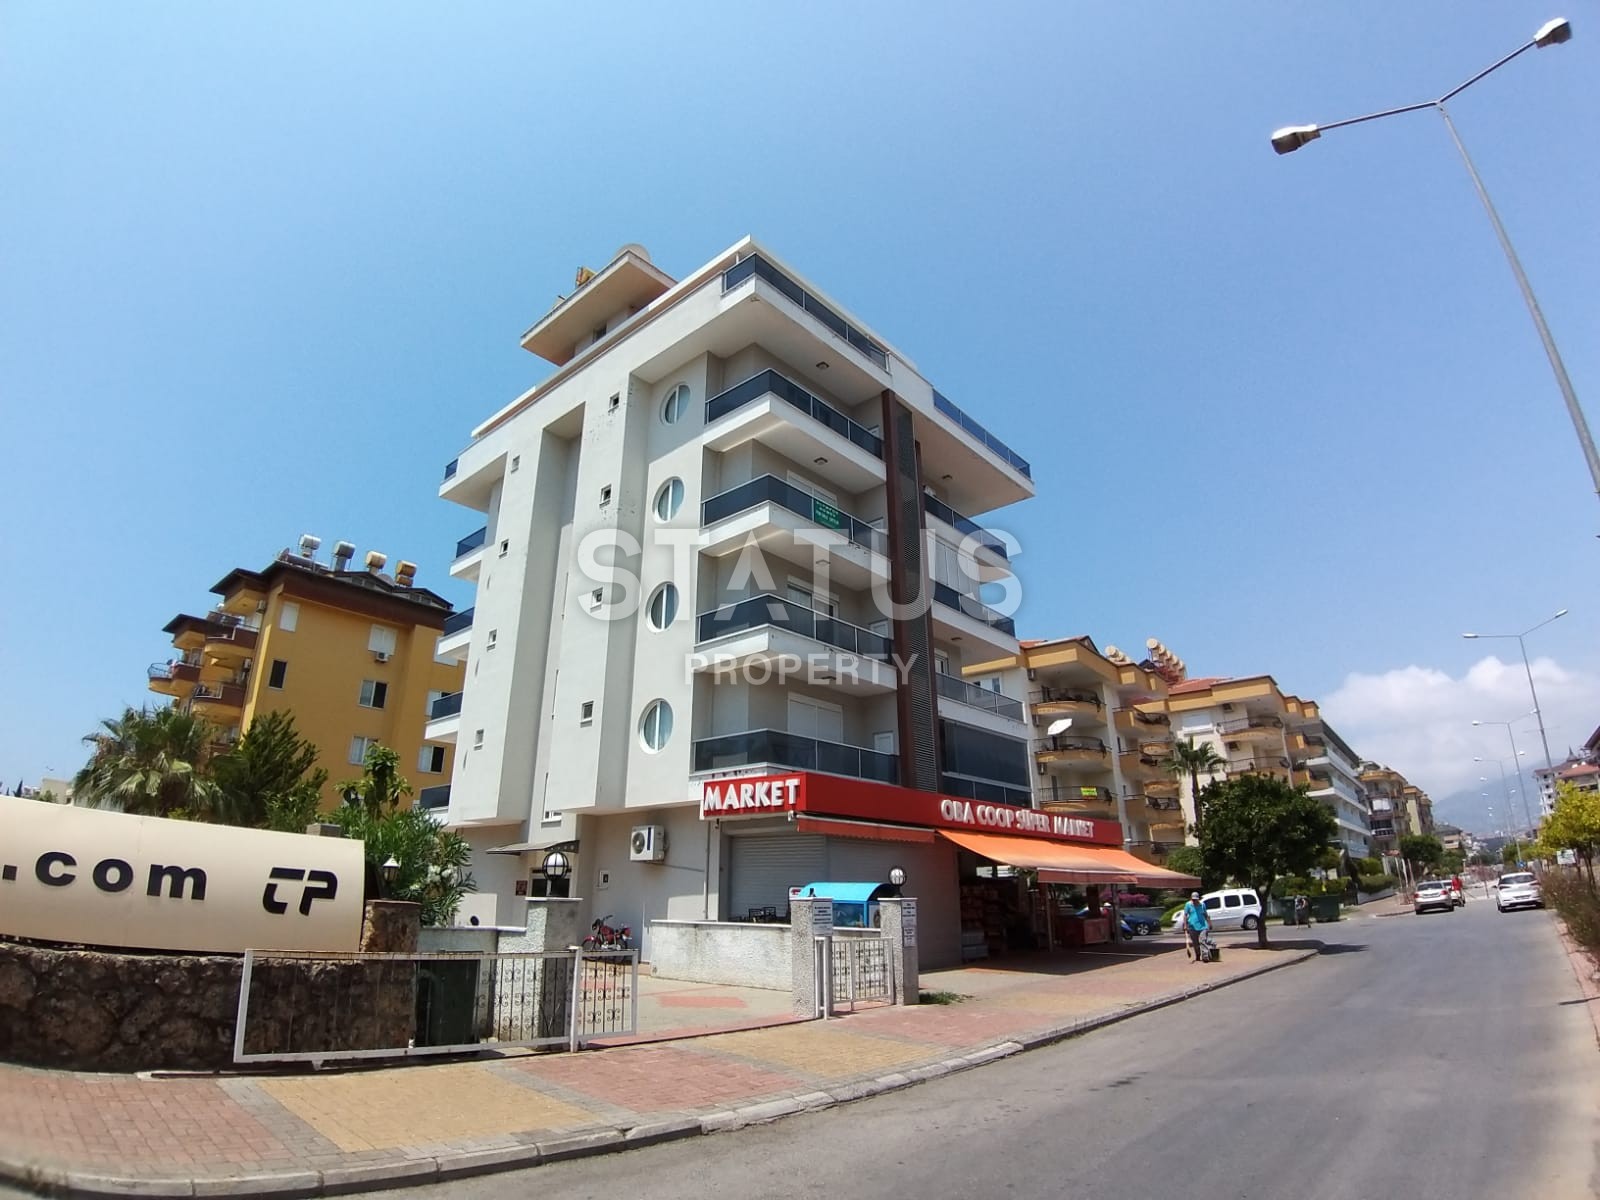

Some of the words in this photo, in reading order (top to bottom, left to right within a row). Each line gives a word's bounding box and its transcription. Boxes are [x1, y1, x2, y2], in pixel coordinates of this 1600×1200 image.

[704, 778, 800, 811] MARKET
[940, 799, 976, 825] OBA
[976, 804, 1015, 828] COOP
[2, 851, 208, 901] .com
